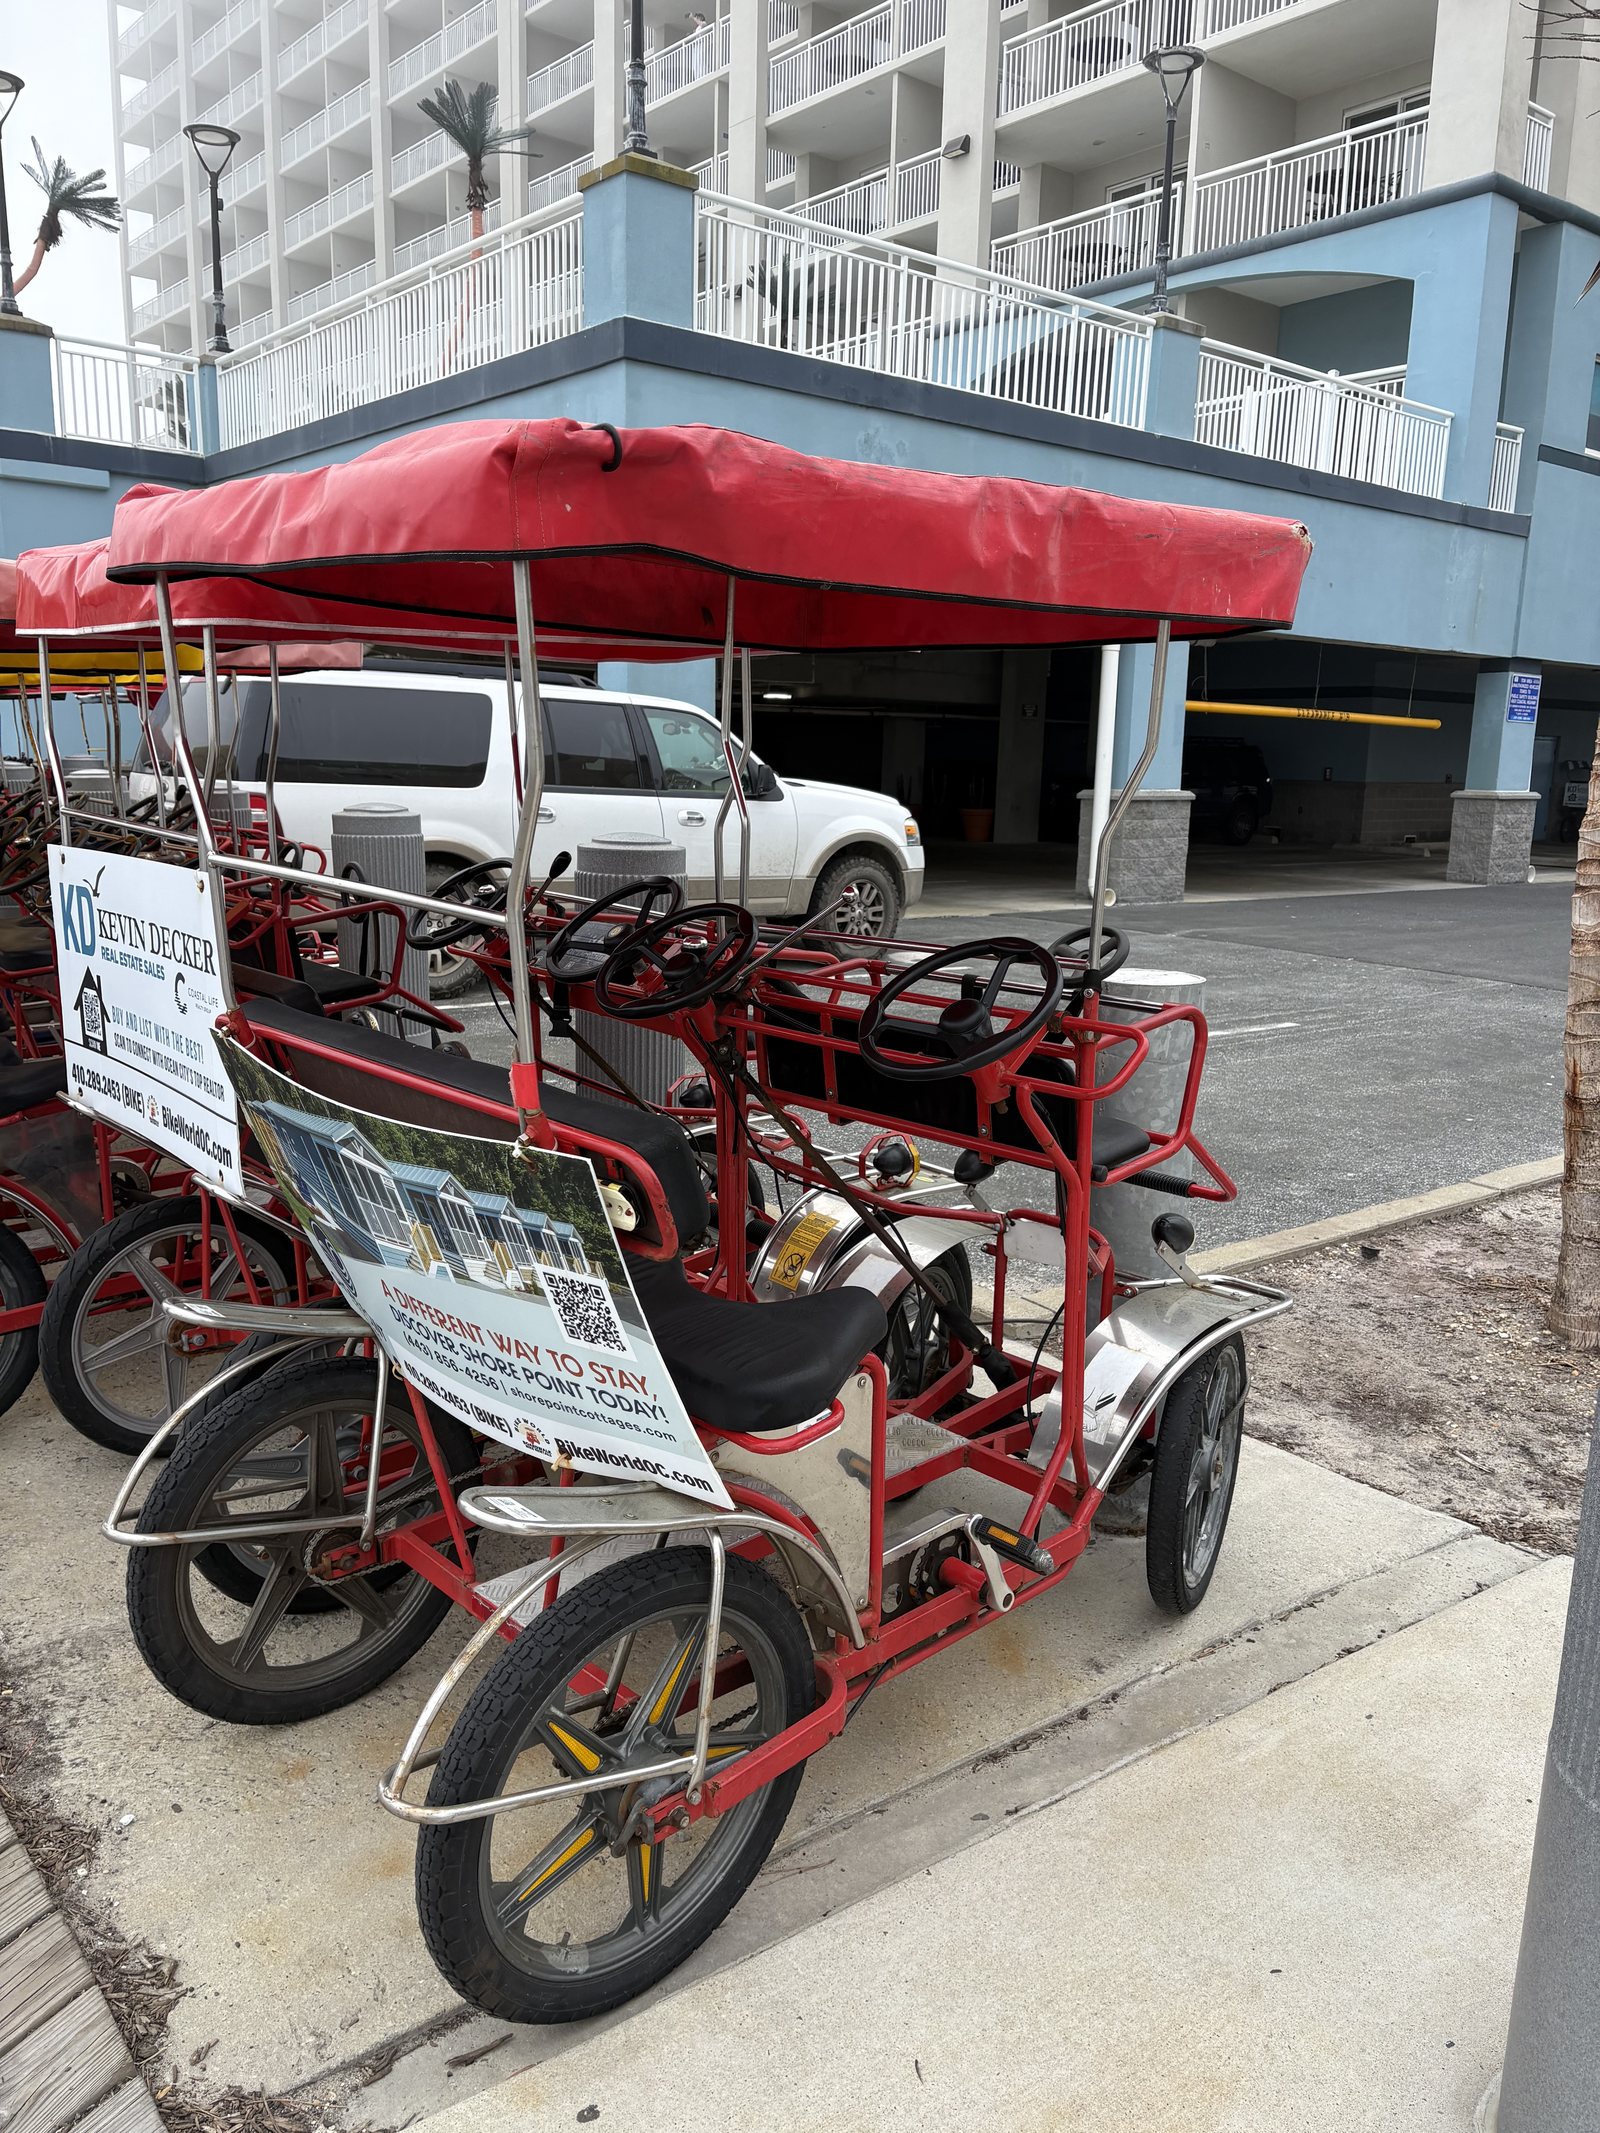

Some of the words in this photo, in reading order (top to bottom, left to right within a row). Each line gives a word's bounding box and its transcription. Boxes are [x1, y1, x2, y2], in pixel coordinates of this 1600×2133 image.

[59, 882, 96, 957] KD
[97, 908, 146, 952] KEVIN
[149, 922, 216, 976] DECKER
[101, 946, 118, 964] REAL
[119, 953, 143, 972] ESTATE
[144, 962, 165, 980] SALES
[112, 1005, 123, 1026] BUY
[125, 1011, 138, 1032] AND
[139, 1017, 152, 1039] LIST
[154, 1023, 170, 1048] WITH
[171, 1031, 184, 1054] THE
[185, 1037, 204, 1064] BEST!
[114, 1032, 126, 1051] SCAN
[126, 1037, 132, 1054] TO
[132, 1040, 152, 1063] CONNECT
[152, 1049, 164, 1069] WITH
[164, 1055, 179, 1077] OCEAN
[179, 1063, 194, 1085] CITY'S
[194, 1070, 203, 1089] TOP
[203, 1075, 225, 1102] REALTOR
[72, 1063, 121, 1103] 410.289.2453
[121, 1083, 146, 1119] (BIKE)
[162, 1105, 233, 1170] BikeWorldOC.com
[381, 1278, 396, 1302] A
[393, 1286, 485, 1347] DIFFERENT
[486, 1329, 541, 1366] WAY
[545, 1348, 584, 1378] TO
[588, 1361, 658, 1402] STAY,
[389, 1304, 459, 1355] DISCOVER
[460, 1342, 521, 1382] SHORE
[521, 1366, 584, 1400] POINT
[586, 1385, 670, 1424] TODAY!
[403, 1331, 434, 1360] (443)
[434, 1350, 500, 1391] 856-4256
[511, 1386, 677, 1443] shorepointcottages.com
[403, 1360, 471, 1415] 410.289.2453
[470, 1402, 513, 1438] (BIKE)
[554, 1437, 714, 1494] BikeWorldOC.com
